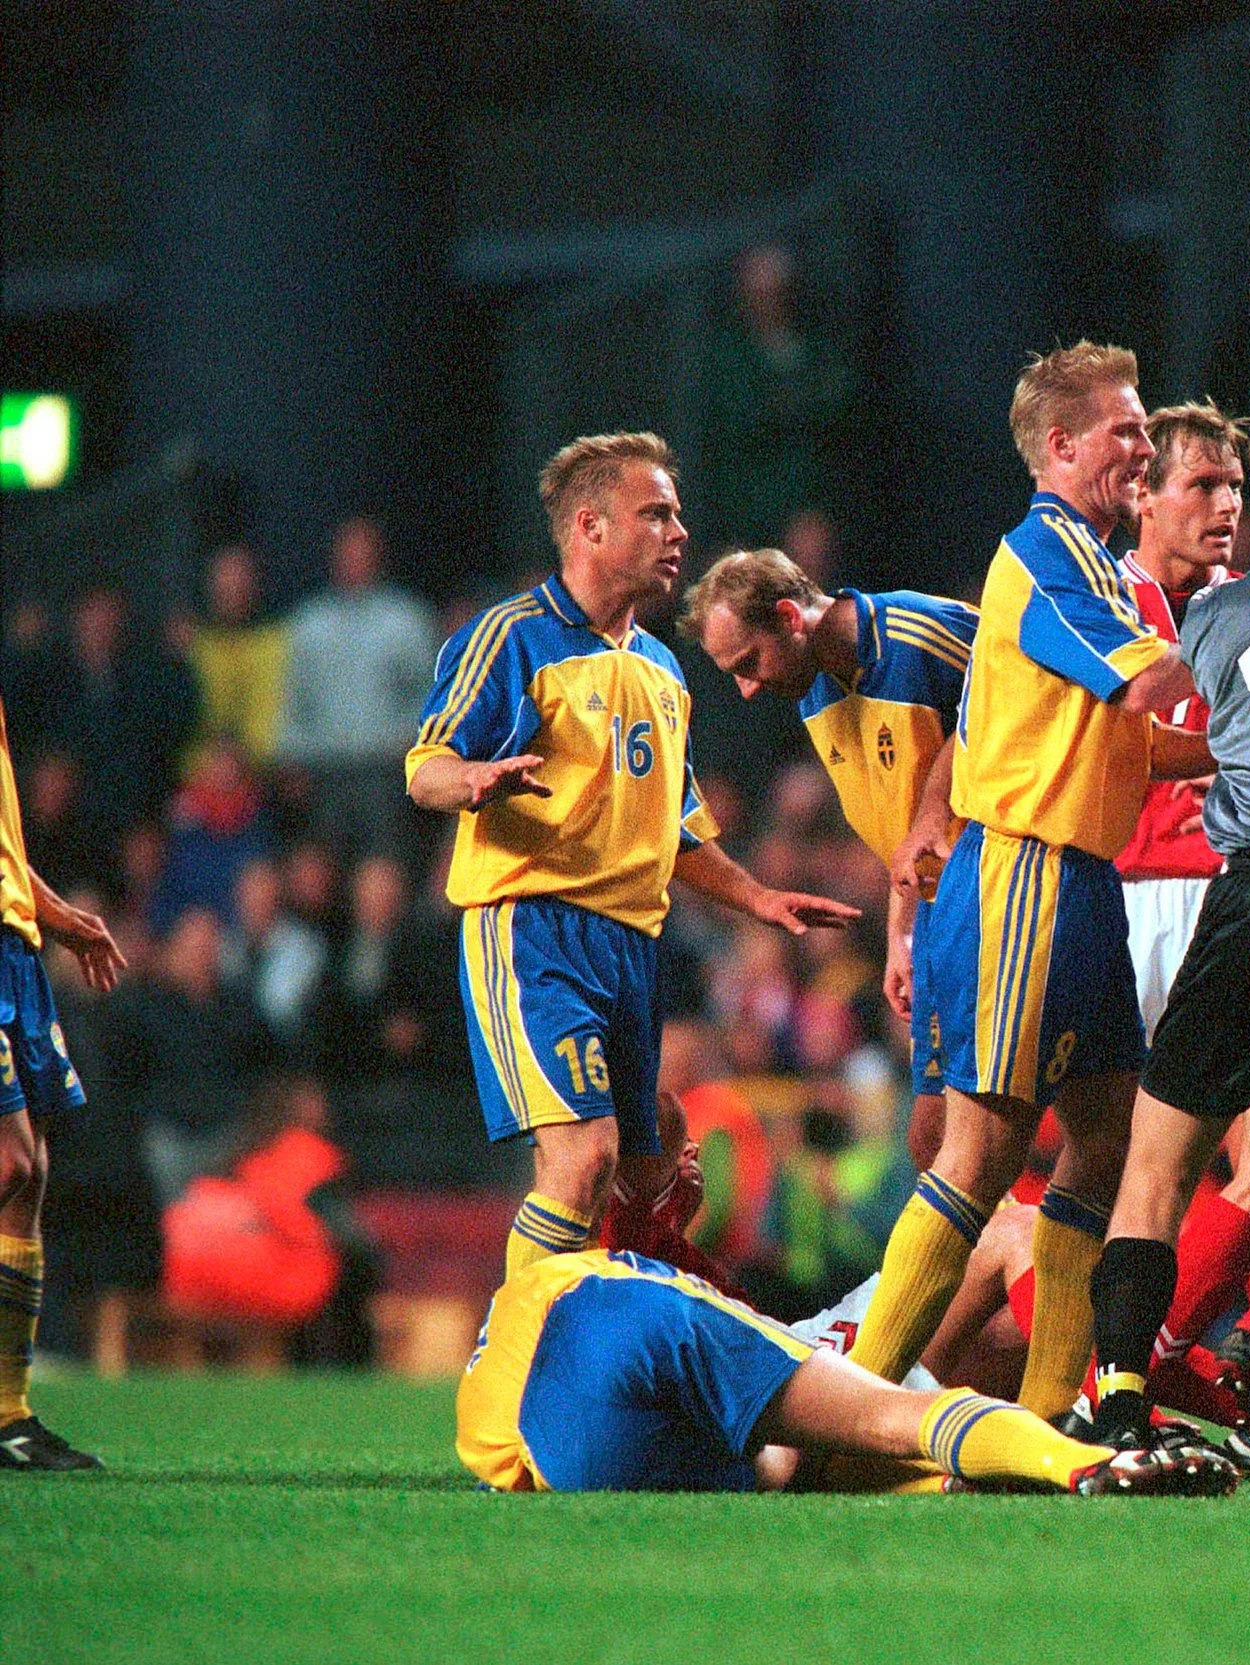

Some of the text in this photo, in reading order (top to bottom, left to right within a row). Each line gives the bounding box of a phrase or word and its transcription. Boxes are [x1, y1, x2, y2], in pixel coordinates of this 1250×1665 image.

[611, 713, 654, 779] 16
[554, 1036, 610, 1094] 16
[1044, 1029, 1077, 1083] 8
